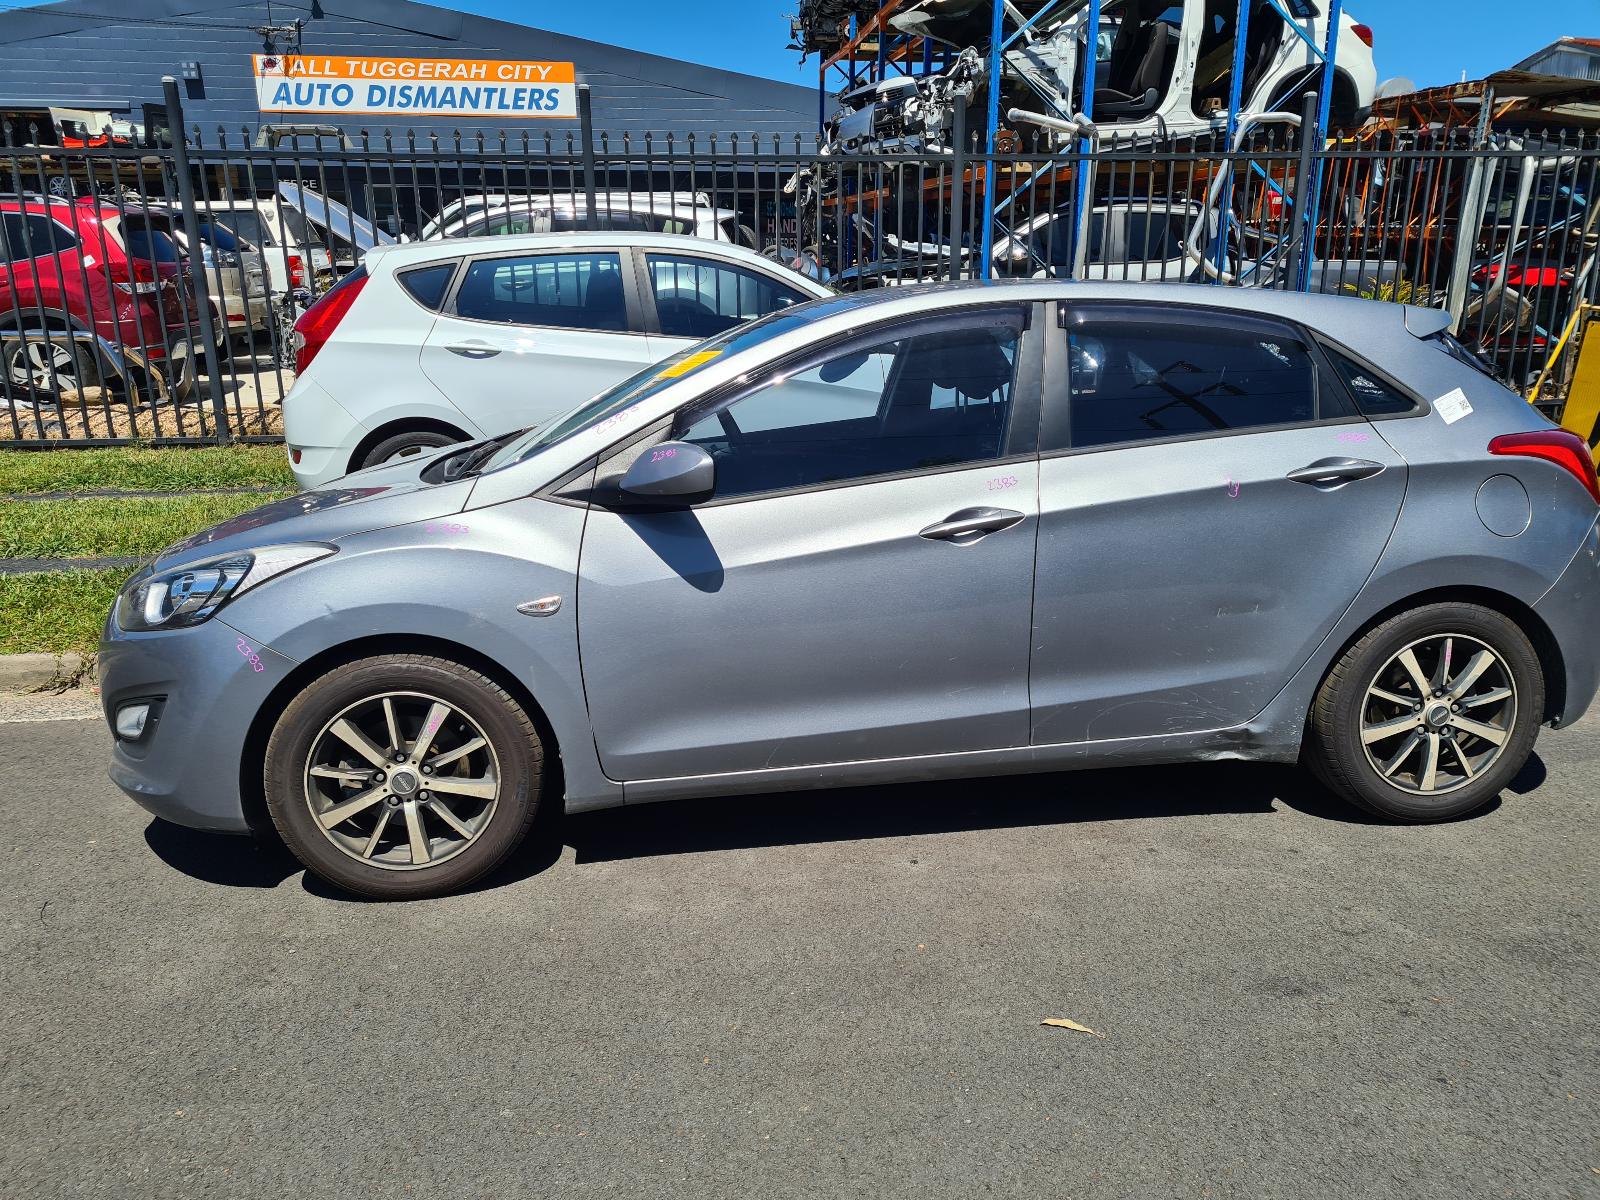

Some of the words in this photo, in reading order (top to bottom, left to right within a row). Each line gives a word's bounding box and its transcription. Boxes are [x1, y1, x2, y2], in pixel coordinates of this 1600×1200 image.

[289, 59, 338, 76] ALL
[345, 60, 488, 80] TUGGERAH
[497, 64, 552, 81] CITY
[272, 82, 354, 107] AUTO
[366, 84, 560, 111] DISMANTLERS
